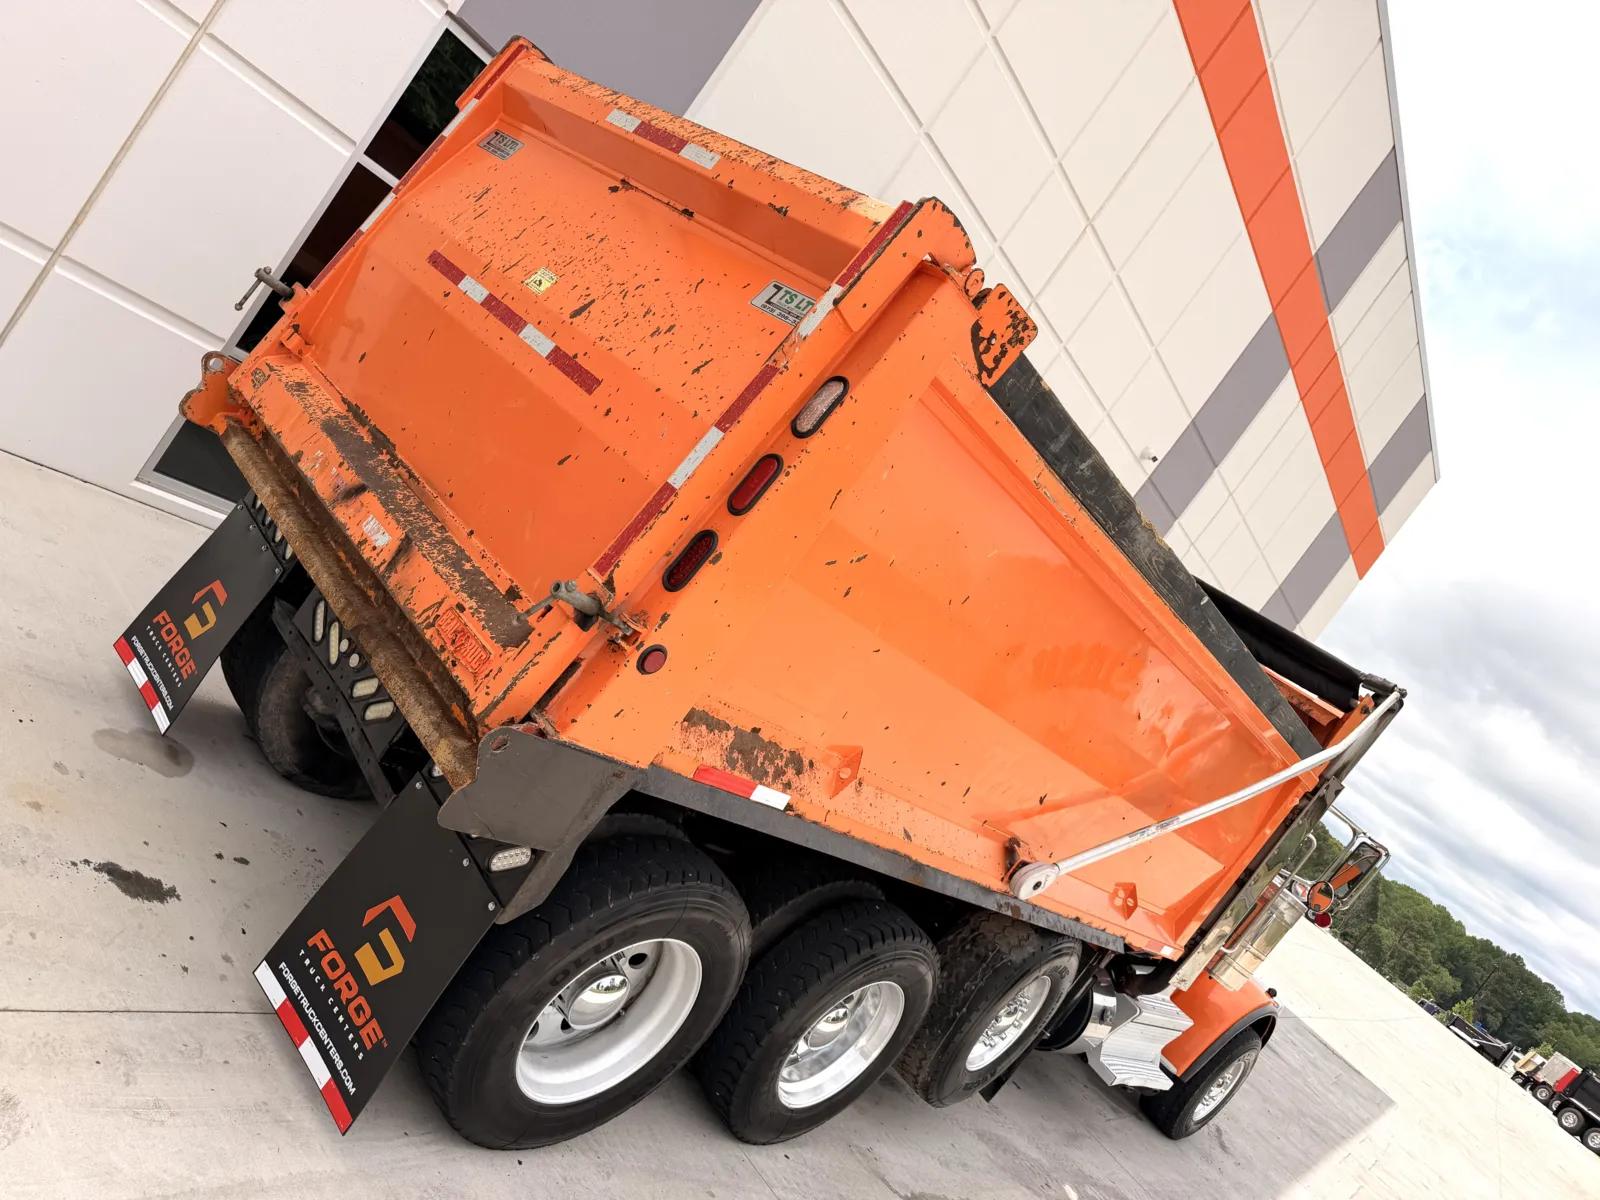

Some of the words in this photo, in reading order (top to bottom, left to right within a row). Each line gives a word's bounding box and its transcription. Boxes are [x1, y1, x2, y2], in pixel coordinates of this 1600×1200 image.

[795, 298, 815, 312] LT
[131, 635, 174, 711] FORGETRUCKCENTERS.COM
[152, 610, 197, 680] FORGE
[162, 652, 182, 688] CENTERS
[299, 949, 326, 992] TRUCK
[328, 997, 364, 1061] CENTERS
[306, 928, 384, 1050] FORGE
[278, 961, 357, 1096] FORGETRUCKCENTERS.COM
